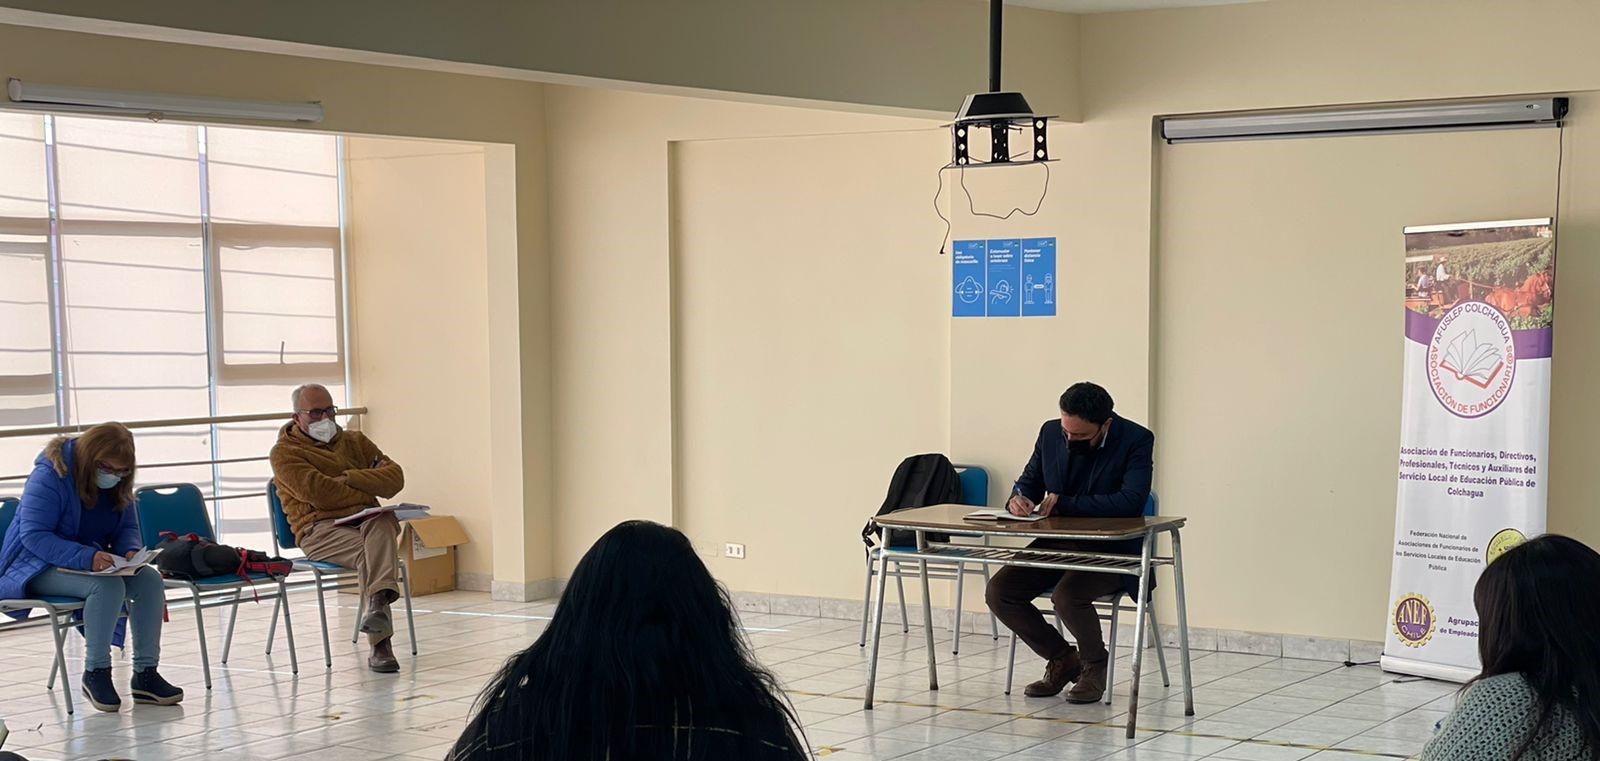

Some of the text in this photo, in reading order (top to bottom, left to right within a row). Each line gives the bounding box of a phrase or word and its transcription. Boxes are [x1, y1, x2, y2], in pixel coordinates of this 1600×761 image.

[1434, 303, 1511, 345] AFUSLEP COLCHAGUA
[1430, 345, 1458, 409] ASOCIACIÓN
[1457, 403, 1469, 414] DE
[1400, 446, 1537, 462] Asociación de Funcionarios, Directivos,
[1400, 459, 1536, 474] Profesionales, Técnicos y Auxiliares del
[1399, 471, 1427, 481] Servicio
[1428, 473, 1448, 482] Local
[1449, 475, 1458, 483] de
[1459, 474, 1498, 485] Educación
[1525, 479, 1536, 488] de
[1447, 487, 1484, 498] Colchagua
[1410, 530, 1438, 538] Federación
[1398, 540, 1431, 549] Asociaciones
[1439, 543, 1471, 552] Funcionarios
[1403, 551, 1427, 559] Servicios
[1397, 599, 1428, 626] ANEF
[1401, 625, 1427, 639] CHILE
[1448, 628, 1479, 638] Empleado
